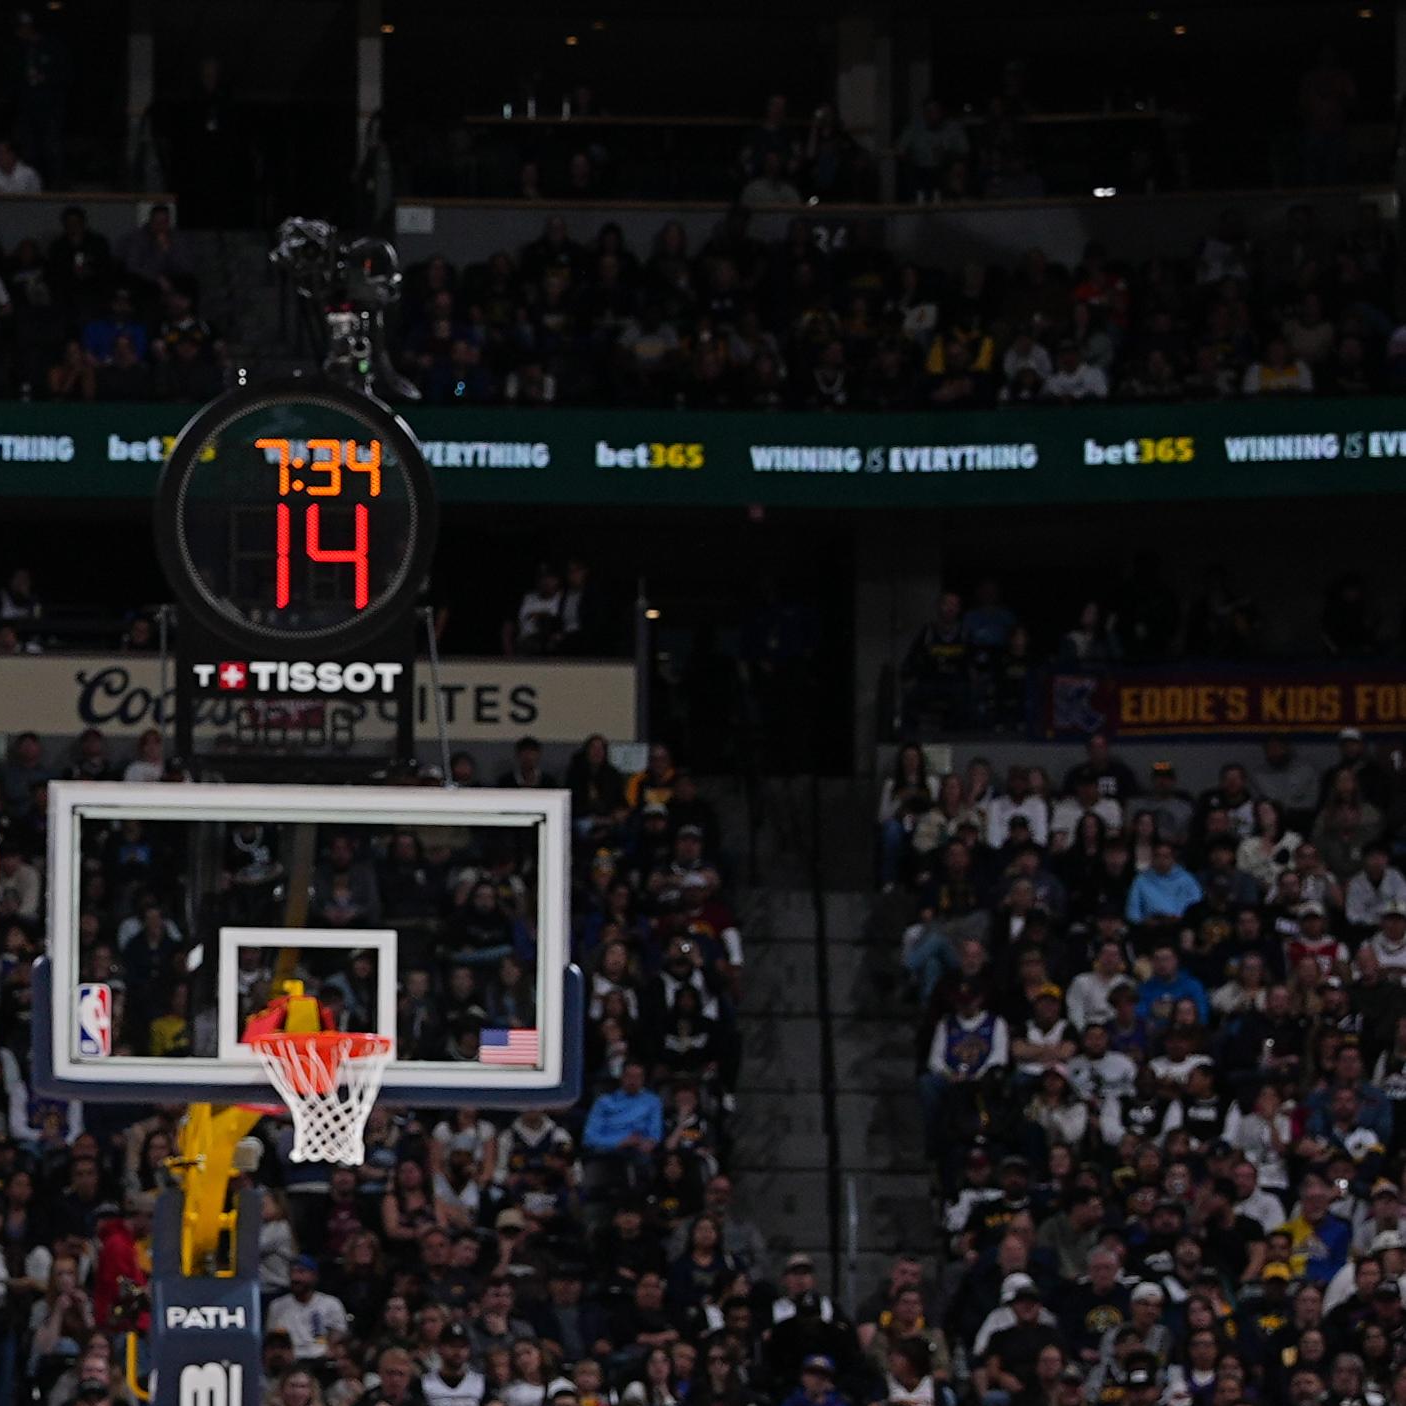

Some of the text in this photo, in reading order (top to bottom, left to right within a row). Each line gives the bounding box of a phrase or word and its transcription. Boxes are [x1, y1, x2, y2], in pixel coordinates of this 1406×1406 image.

[415, 440, 550, 468] VERYTHING
[596, 442, 703, 468] bet365
[750, 446, 862, 472] WINNING
[889, 444, 1038, 472] EVERYTHING
[1085, 438, 1193, 465] bet365
[1225, 434, 1339, 461] WINNING
[255, 438, 382, 497] 7:34
[276, 504, 369, 609] 14
[249, 662, 403, 692] TISSOT
[1119, 685, 1250, 722] EDDIE'S
[1259, 685, 1342, 722] KIDS
[166, 1305, 246, 1330] PATH
